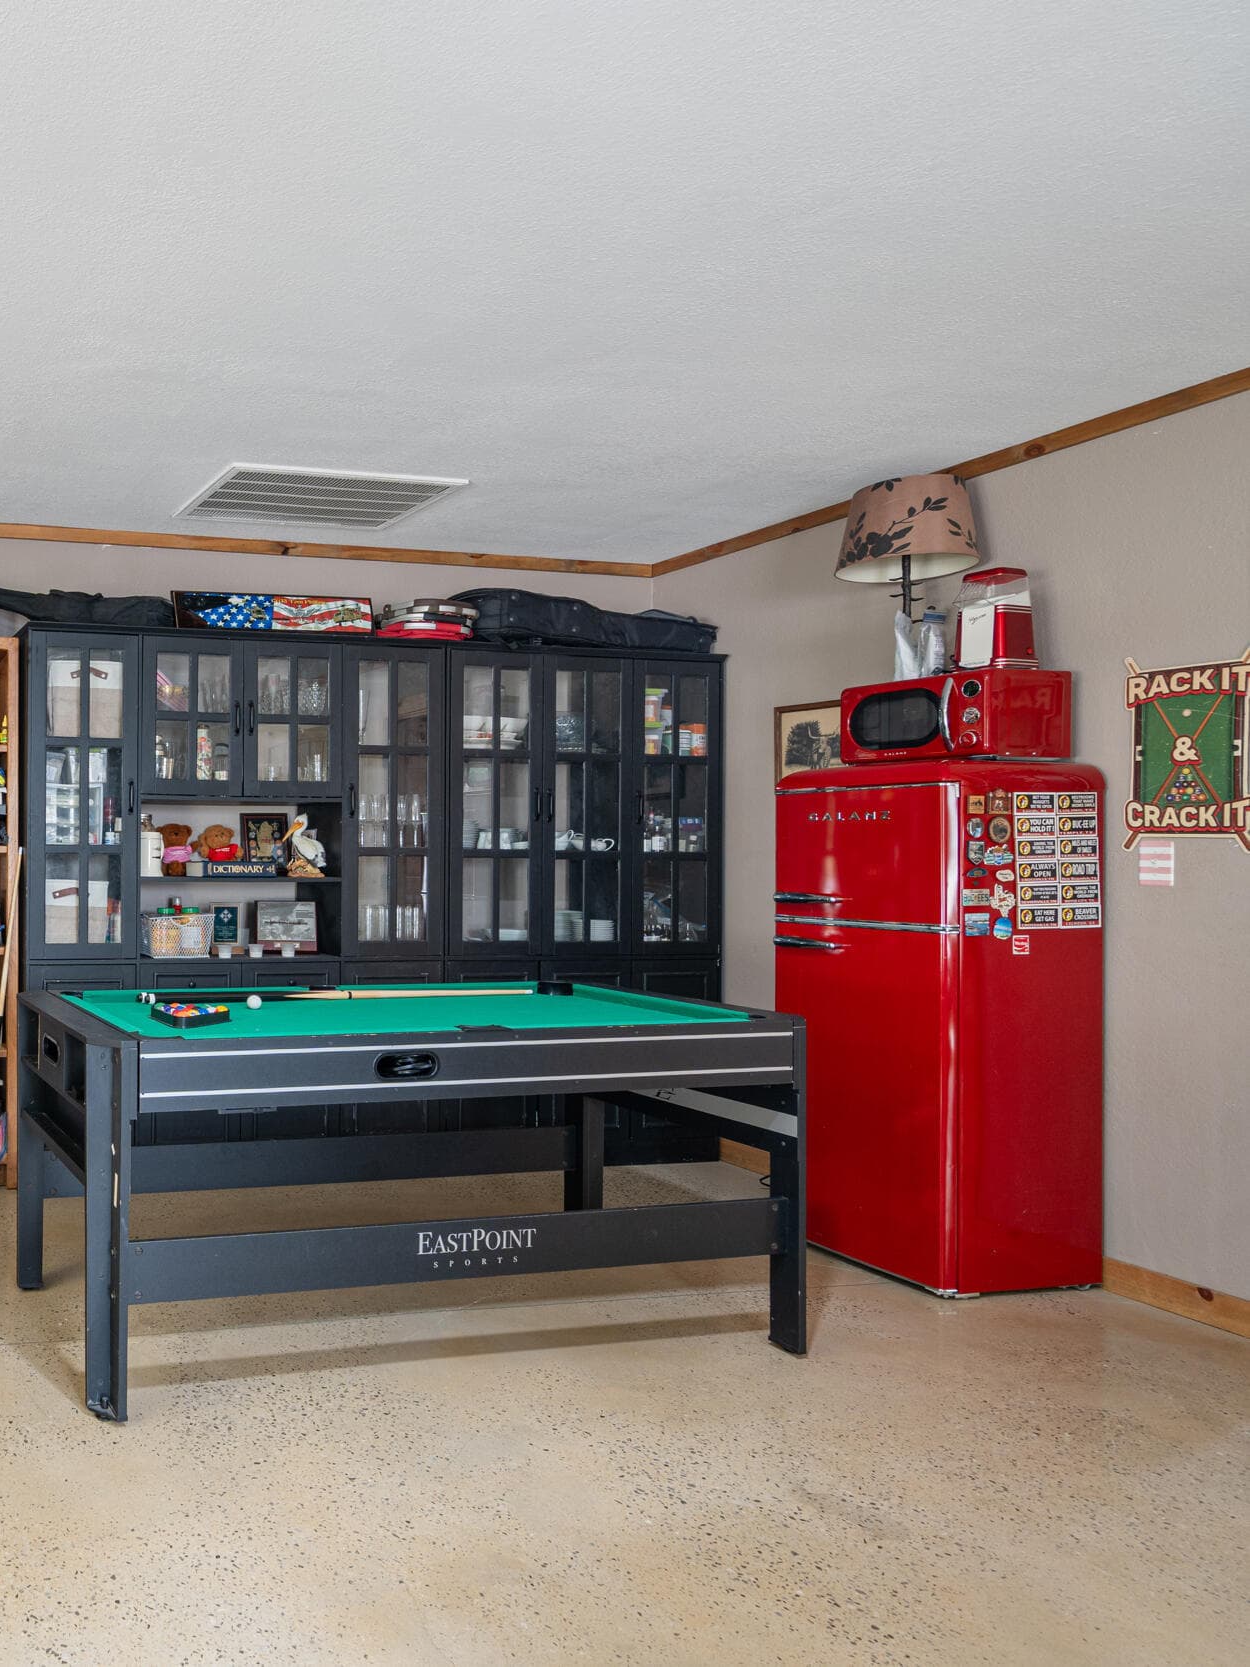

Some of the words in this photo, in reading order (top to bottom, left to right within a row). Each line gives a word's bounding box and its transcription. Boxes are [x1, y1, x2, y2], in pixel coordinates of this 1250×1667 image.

[1128, 668, 1215, 705] RACK
[1222, 664, 1250, 692] IT
[1173, 737, 1199, 761] &
[808, 810, 892, 821] GALANZ
[1127, 802, 1218, 828] CRACK
[1223, 799, 1250, 827] IT
[213, 864, 263, 874] DICTIONARY
[417, 1228, 537, 1255] EASTPOINT
[433, 1256, 518, 1268] SPORTS
